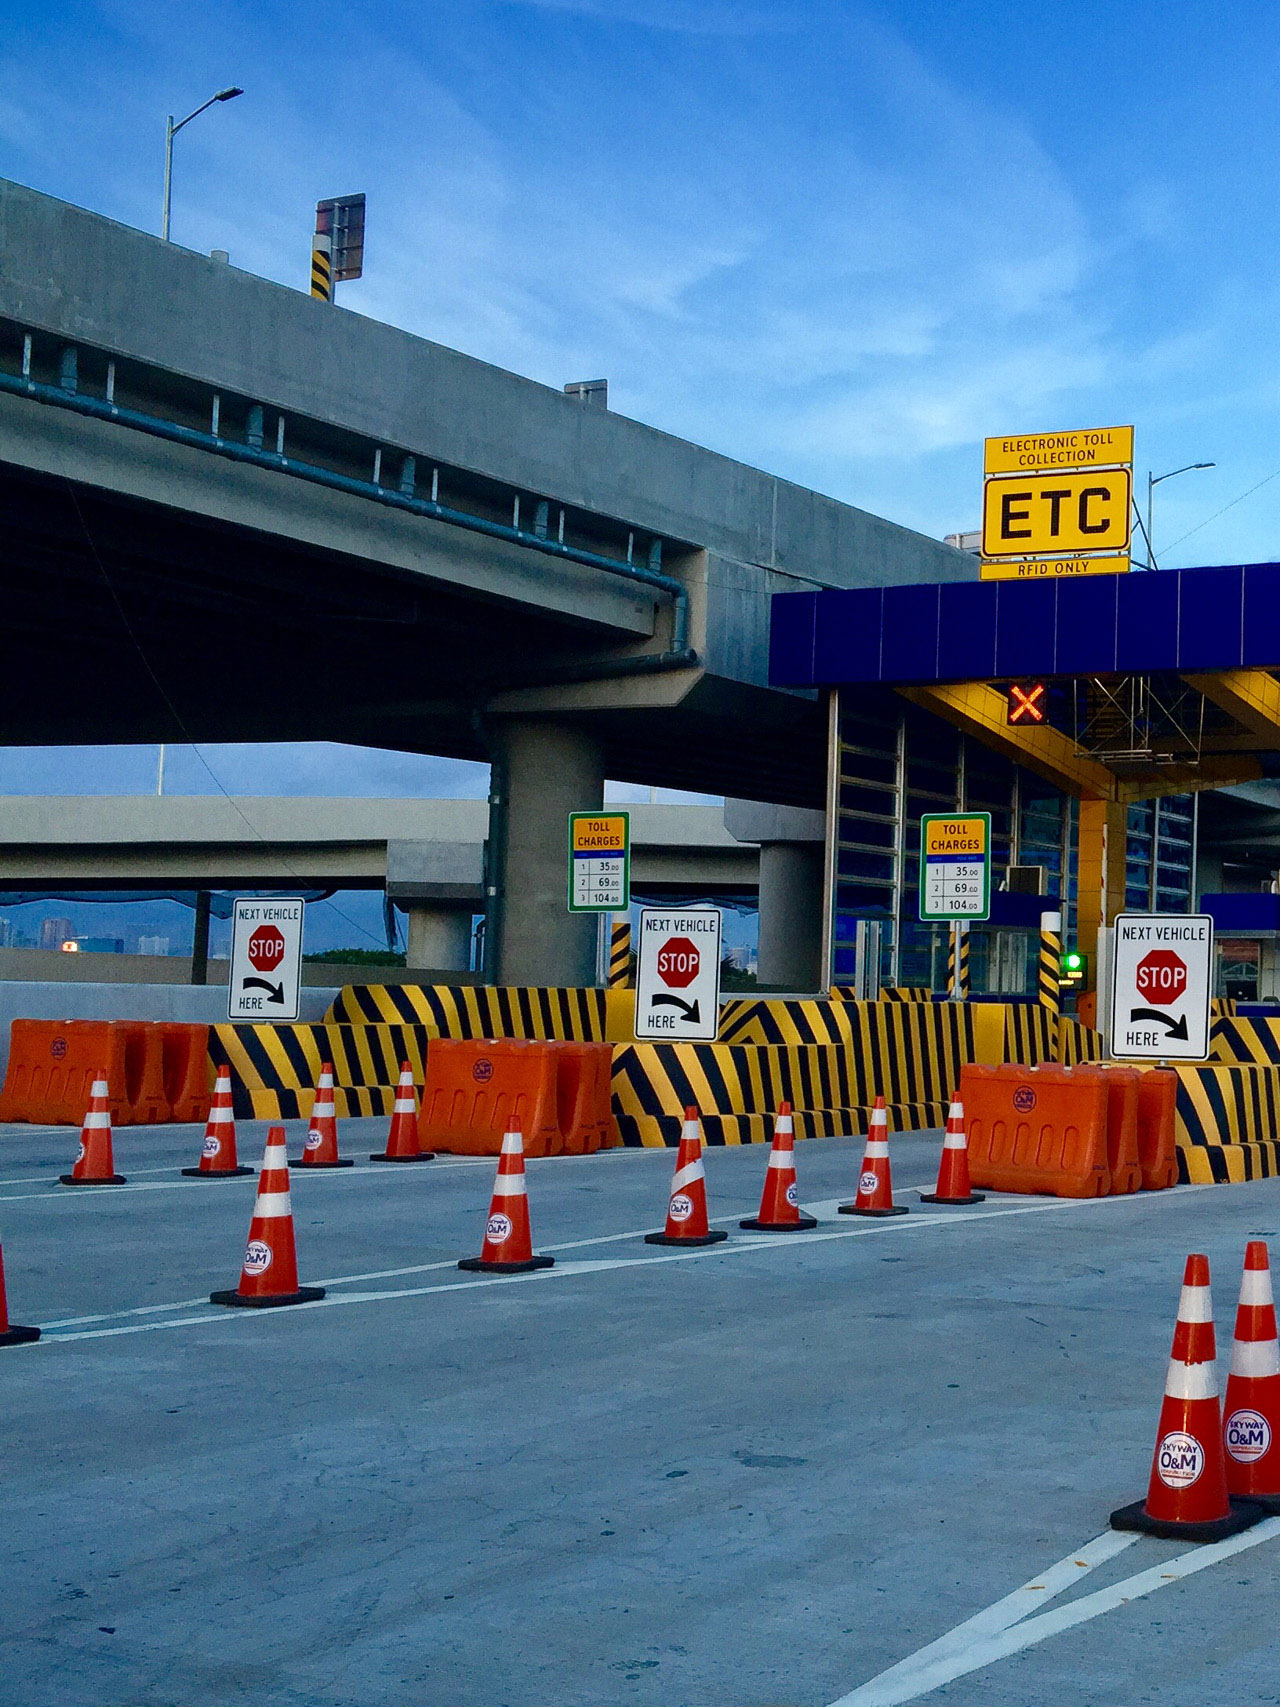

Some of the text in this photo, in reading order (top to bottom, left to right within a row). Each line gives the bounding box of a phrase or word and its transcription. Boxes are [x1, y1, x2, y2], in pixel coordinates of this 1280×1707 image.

[1002, 432, 1114, 453] ELECTRONIC TOLL
[1019, 449, 1096, 466] COLLECTION
[1000, 486, 1111, 540] ETC
[1018, 561, 1090, 576] RFID ONLY
[588, 822, 610, 832] TOLL
[943, 824, 968, 835] TOLL
[578, 836, 620, 846] CHARGES
[931, 839, 980, 850] CHARGES
[956, 866, 978, 877] 35.00
[955, 883, 978, 893] 69.00
[949, 900, 978, 910] 104.00
[239, 908, 299, 920] NEXT VEHICLE
[645, 919, 716, 932] NEXT VEHICLE
[1122, 926, 1206, 941] NEXT VEHICLE
[249, 939, 284, 958] STOP
[659, 952, 699, 973] STOP
[1138, 966, 1186, 989] STOP
[239, 997, 263, 1009] HERE
[647, 1014, 676, 1029] HERE
[1126, 1031, 1159, 1047] HERE
[1228, 1429, 1264, 1446] O&M
[1160, 1452, 1197, 1471] O&M
